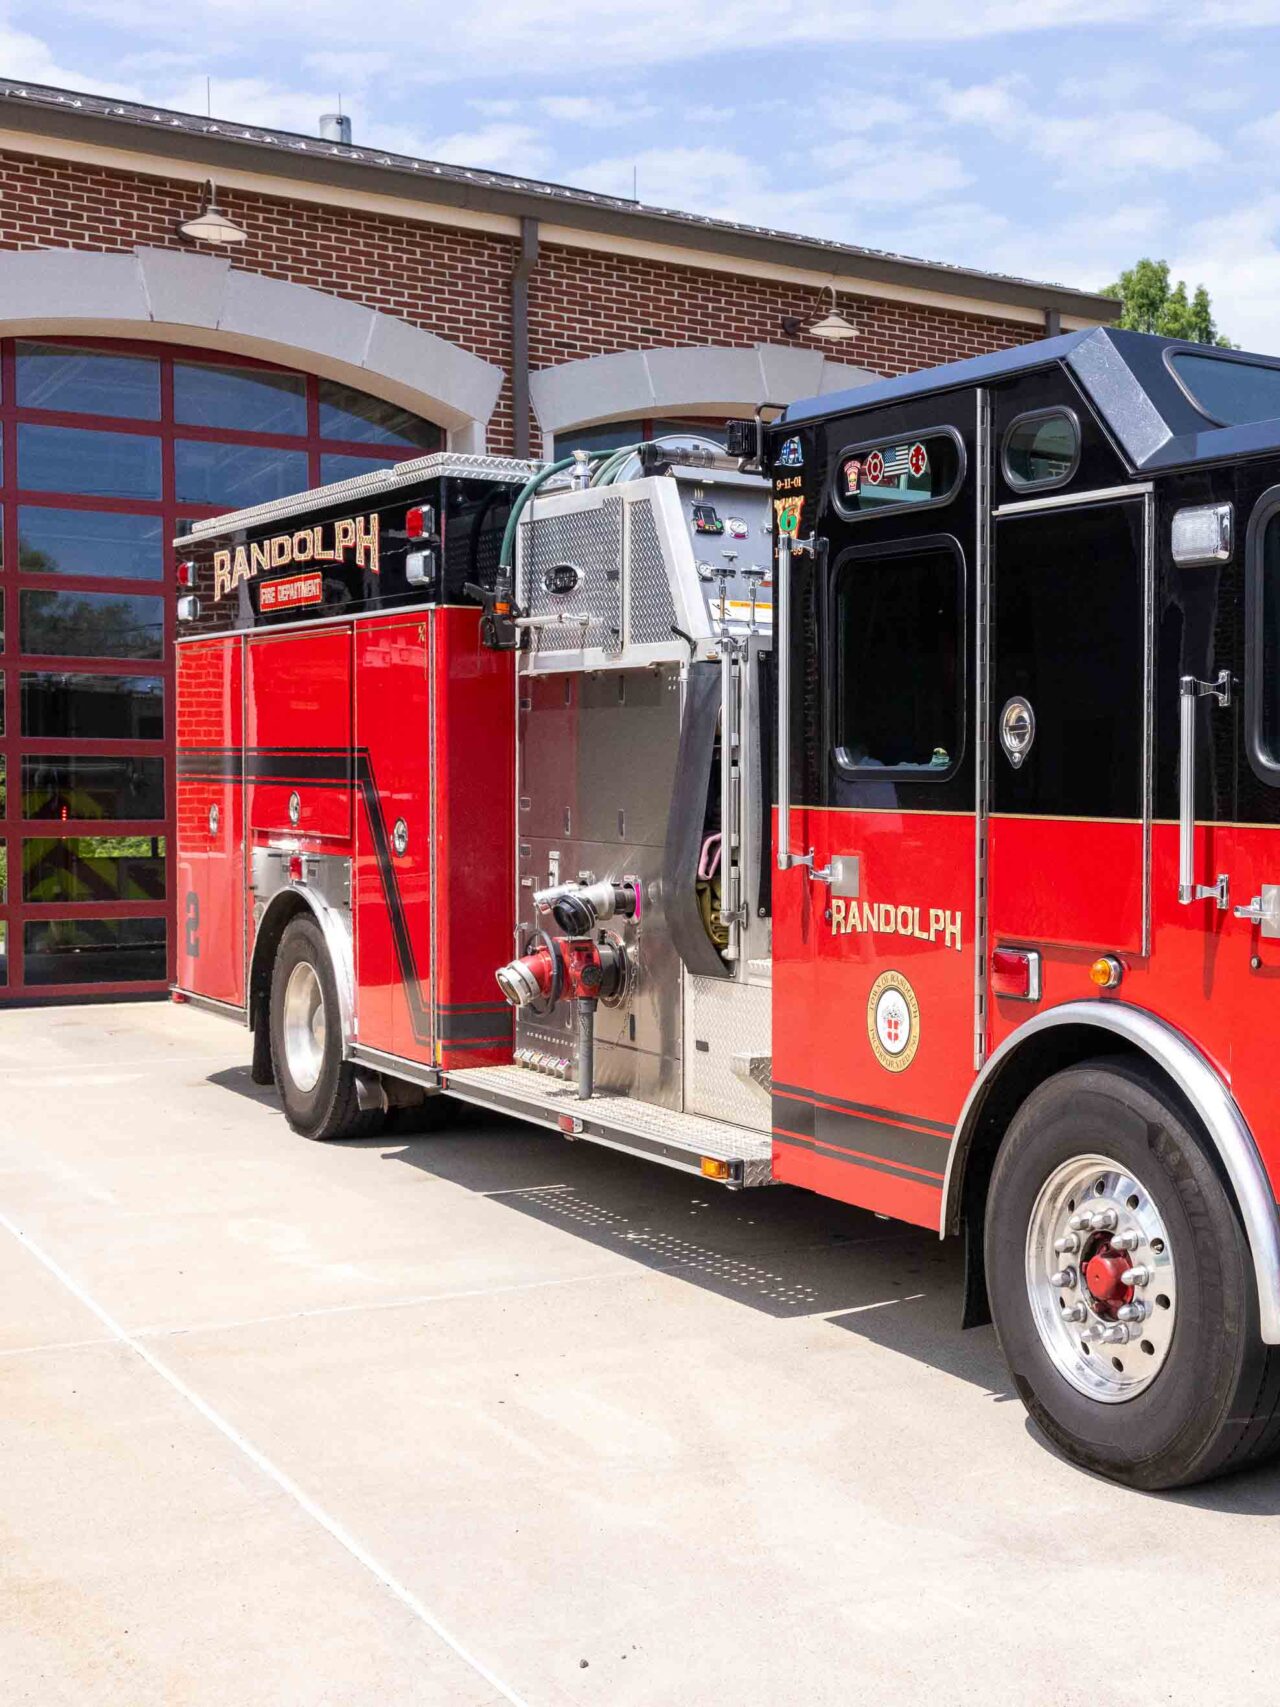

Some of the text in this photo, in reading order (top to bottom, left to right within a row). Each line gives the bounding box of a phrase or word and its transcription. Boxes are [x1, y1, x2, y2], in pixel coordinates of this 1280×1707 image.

[776, 476, 802, 491] 9-11-01
[780, 504, 798, 532] 6
[213, 513, 380, 602] RANDOLPH
[186, 891, 200, 958] 2
[831, 898, 962, 952] RANDOLPH
